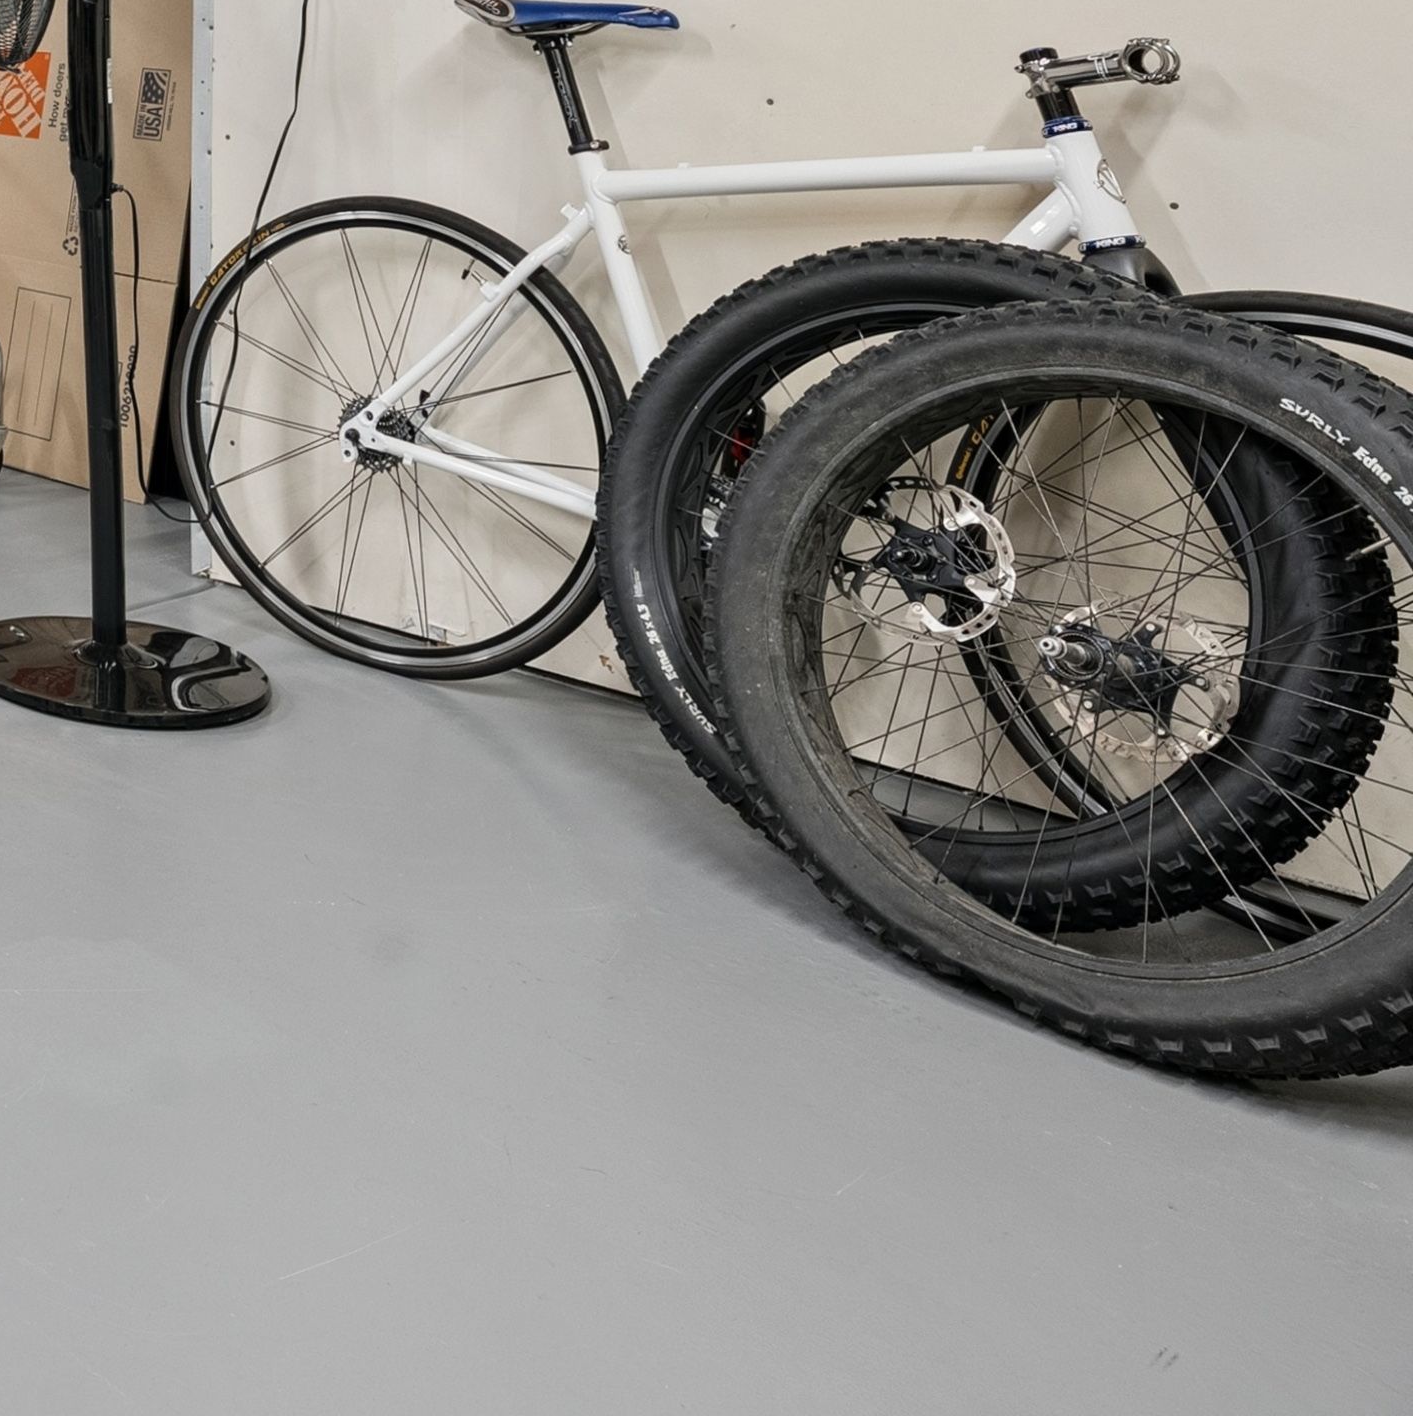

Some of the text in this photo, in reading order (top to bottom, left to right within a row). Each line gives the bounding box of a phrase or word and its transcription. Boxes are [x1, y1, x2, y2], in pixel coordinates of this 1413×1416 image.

[48, 63, 66, 128] How doers
[136, 114, 146, 137] MADE
[143, 106, 164, 138] USA
[1053, 122, 1078, 133] KING
[1095, 236, 1126, 248] KING
[1278, 397, 1352, 446] SURLY
[1353, 445, 1393, 485] Edna
[656, 648, 680, 681] Edna
[674, 685, 718, 735] SURLY
